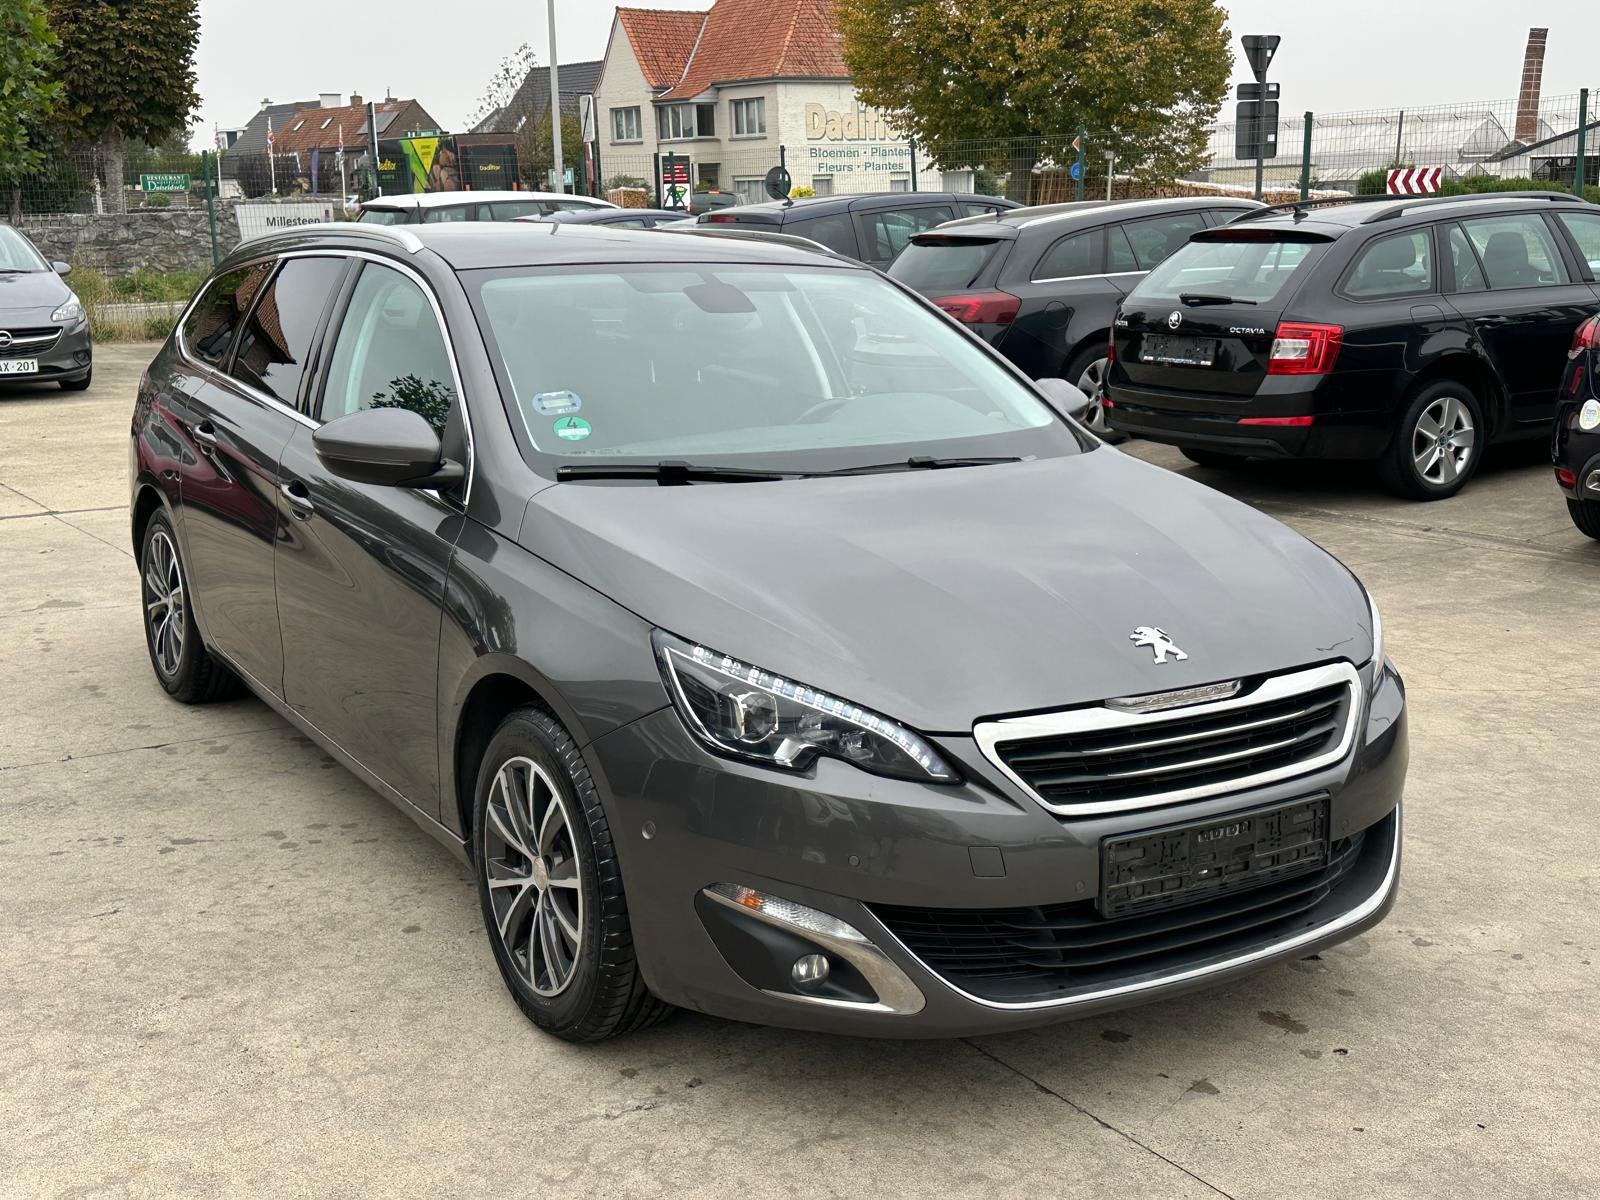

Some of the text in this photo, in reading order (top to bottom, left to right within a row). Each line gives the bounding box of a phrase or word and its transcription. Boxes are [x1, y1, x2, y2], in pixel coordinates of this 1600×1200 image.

[805, 101, 911, 141] Dadifl
[809, 147, 911, 158] Bloemen Planten
[818, 161, 904, 172] Fleurs Plantes
[266, 216, 321, 228] Millesteen
[1229, 326, 1265, 335] OCTAVIA
[566, 417, 578, 429] 4
